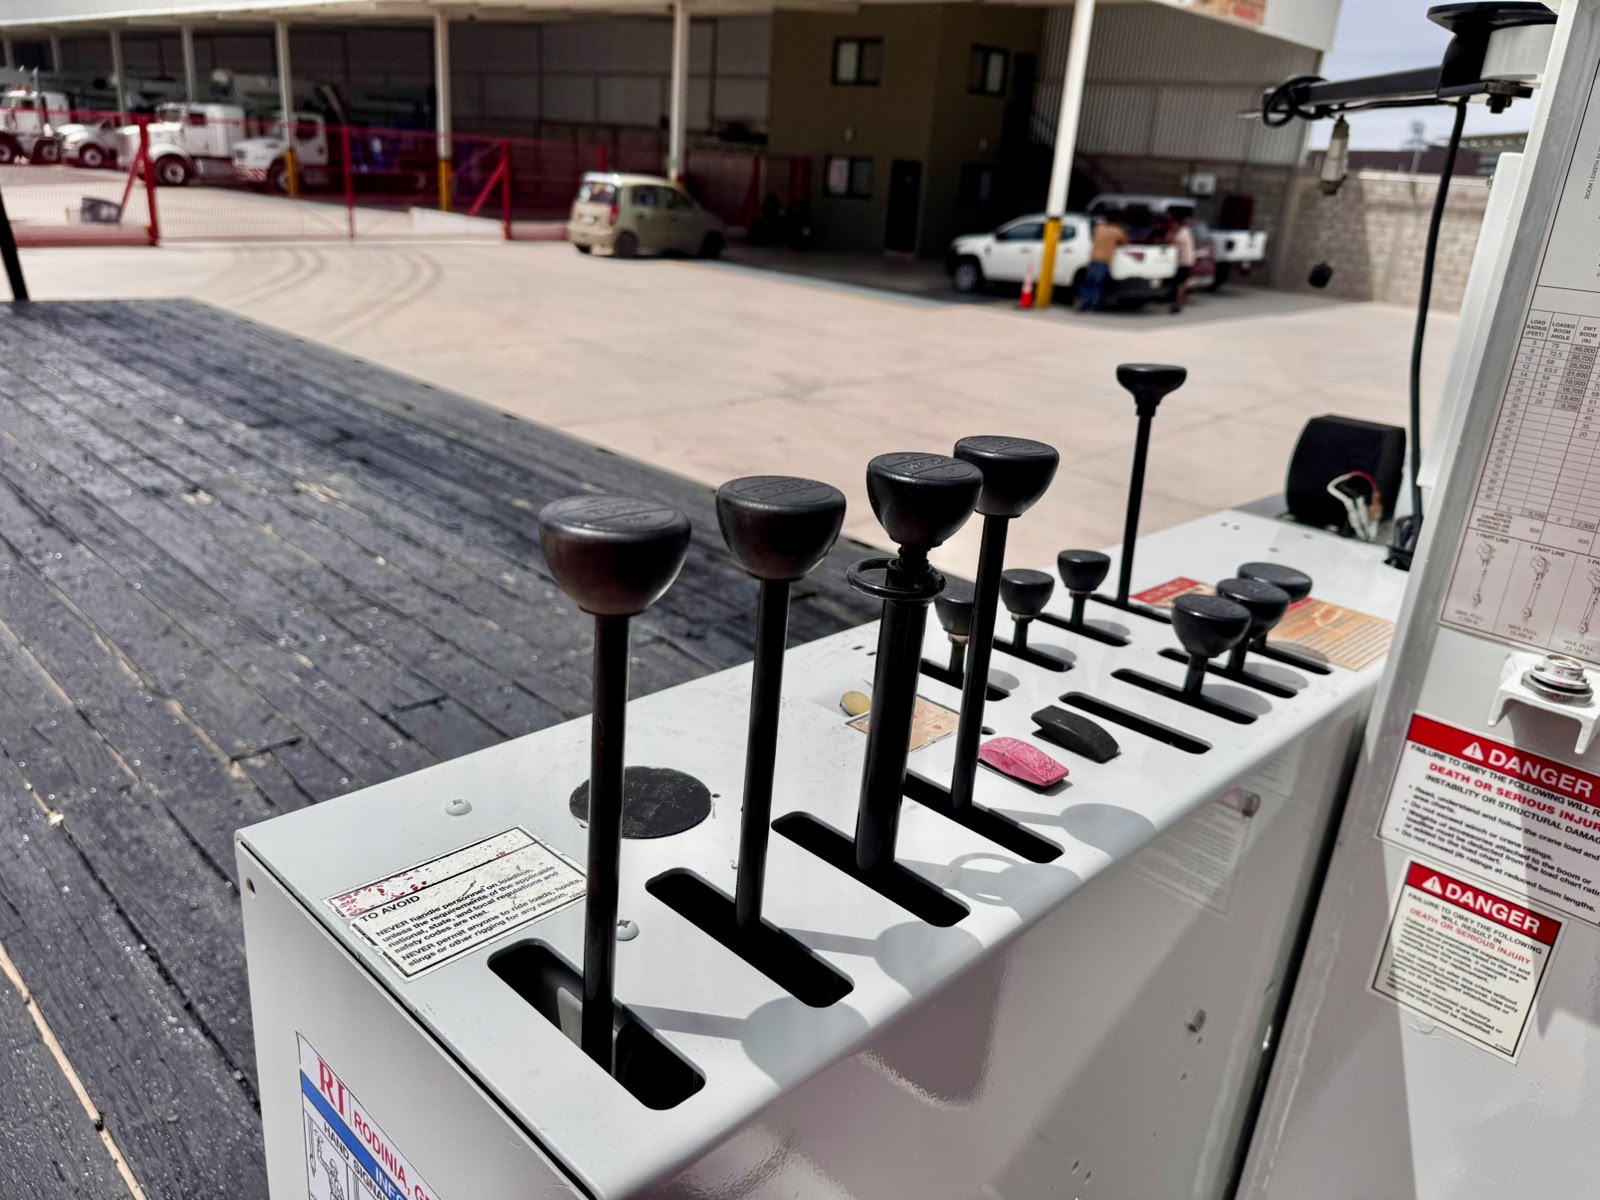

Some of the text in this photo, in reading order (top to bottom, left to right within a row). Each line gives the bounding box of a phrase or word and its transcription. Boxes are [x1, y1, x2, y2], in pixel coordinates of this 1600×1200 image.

[1585, 183, 1593, 199] BOOM
[1574, 346, 1596, 354] 46,000
[1410, 744, 1446, 761] FAILURE
[1447, 757, 1460, 766] TO
[1460, 761, 1486, 776] OBEY
[1489, 771, 1506, 783] THE
[1508, 778, 1565, 804] FOLLOWING
[1566, 799, 1591, 813] WILL
[1428, 762, 1470, 784] DEATH
[1473, 778, 1492, 791] OR
[1495, 786, 1555, 814] SERIOUS
[1487, 748, 1594, 798] DANGER
[1424, 774, 1479, 799] INSTABILITY
[1480, 794, 1496, 806] OR
[1497, 800, 1563, 830] STRUCTURAL
[1437, 795, 1480, 815] understand
[1481, 811, 1496, 821] and
[1497, 817, 1521, 831] follow
[1523, 827, 1537, 837] the
[1538, 832, 1562, 846] crane
[1563, 842, 1582, 853] load
[1583, 849, 1600, 860] and
[1410, 801, 1421, 809] Do
[1422, 805, 1434, 814] not
[1436, 811, 1463, 825] exceed
[1464, 822, 1487, 835] winch
[1499, 835, 1521, 848] crane
[1522, 844, 1554, 861] ratings.
[1437, 835, 1445, 843] to
[1446, 839, 1459, 848] the
[1460, 844, 1477, 855] load
[1478, 852, 1501, 864] chart.
[1438, 821, 1447, 829] of
[1447, 825, 1493, 847] accessories
[1494, 842, 1530, 861] attached
[1531, 856, 1540, 865] to
[1541, 860, 1555, 871] the
[1556, 866, 1580, 880] boom
[1581, 876, 1592, 885] or
[1455, 835, 1465, 843] be
[1466, 839, 1504, 858] deducted
[1504, 854, 1524, 866] from
[1525, 862, 1539, 872] the
[1540, 868, 1558, 879] load
[1559, 875, 1581, 888] chart
[1465, 855, 1493, 871] ratings
[1494, 866, 1502, 874] at
[1503, 870, 1536, 887] reduced
[1538, 884, 1561, 897] boom
[1562, 894, 1596, 913] lengths.
[359, 894, 421, 922] TO AVOID
[375, 920, 409, 936] NEVER
[408, 906, 441, 922] handle
[441, 887, 486, 909] personnel
[484, 882, 498, 890] on
[381, 926, 413, 942] unless
[412, 919, 429, 928] the
[428, 893, 489, 922] requirements
[497, 883, 514, 891] the
[513, 865, 555, 885] applicable
[387, 870, 559, 947] national, state, and local regulations and
[393, 908, 490, 954] safety codes are met.
[400, 942, 435, 960] NEVER
[435, 928, 467, 945] permit
[466, 914, 500, 932] anyone
[509, 901, 528, 911] ride
[528, 889, 556, 903] loads,
[406, 950, 437, 966] slings
[435, 945, 448, 953] or
[447, 933, 473, 947] other
[473, 919, 506, 936] rigging
[505, 912, 519, 921] for
[519, 905, 537, 915] any
[535, 890, 568, 907] reason.
[1407, 892, 1542, 954] FAILURE TO OBEY THE FOLLOWING
[1440, 913, 1502, 944] WILL RESULT IN
[1444, 882, 1541, 934] DANGER
[1409, 907, 1438, 924] DEATH
[1439, 920, 1453, 931] OR
[1455, 927, 1495, 949] SERIOUS
[1497, 946, 1530, 965] INJURY
[317, 1056, 345, 1118] RI
[324, 1122, 350, 1162] HAND
[354, 1110, 410, 1196] RODINIA,
